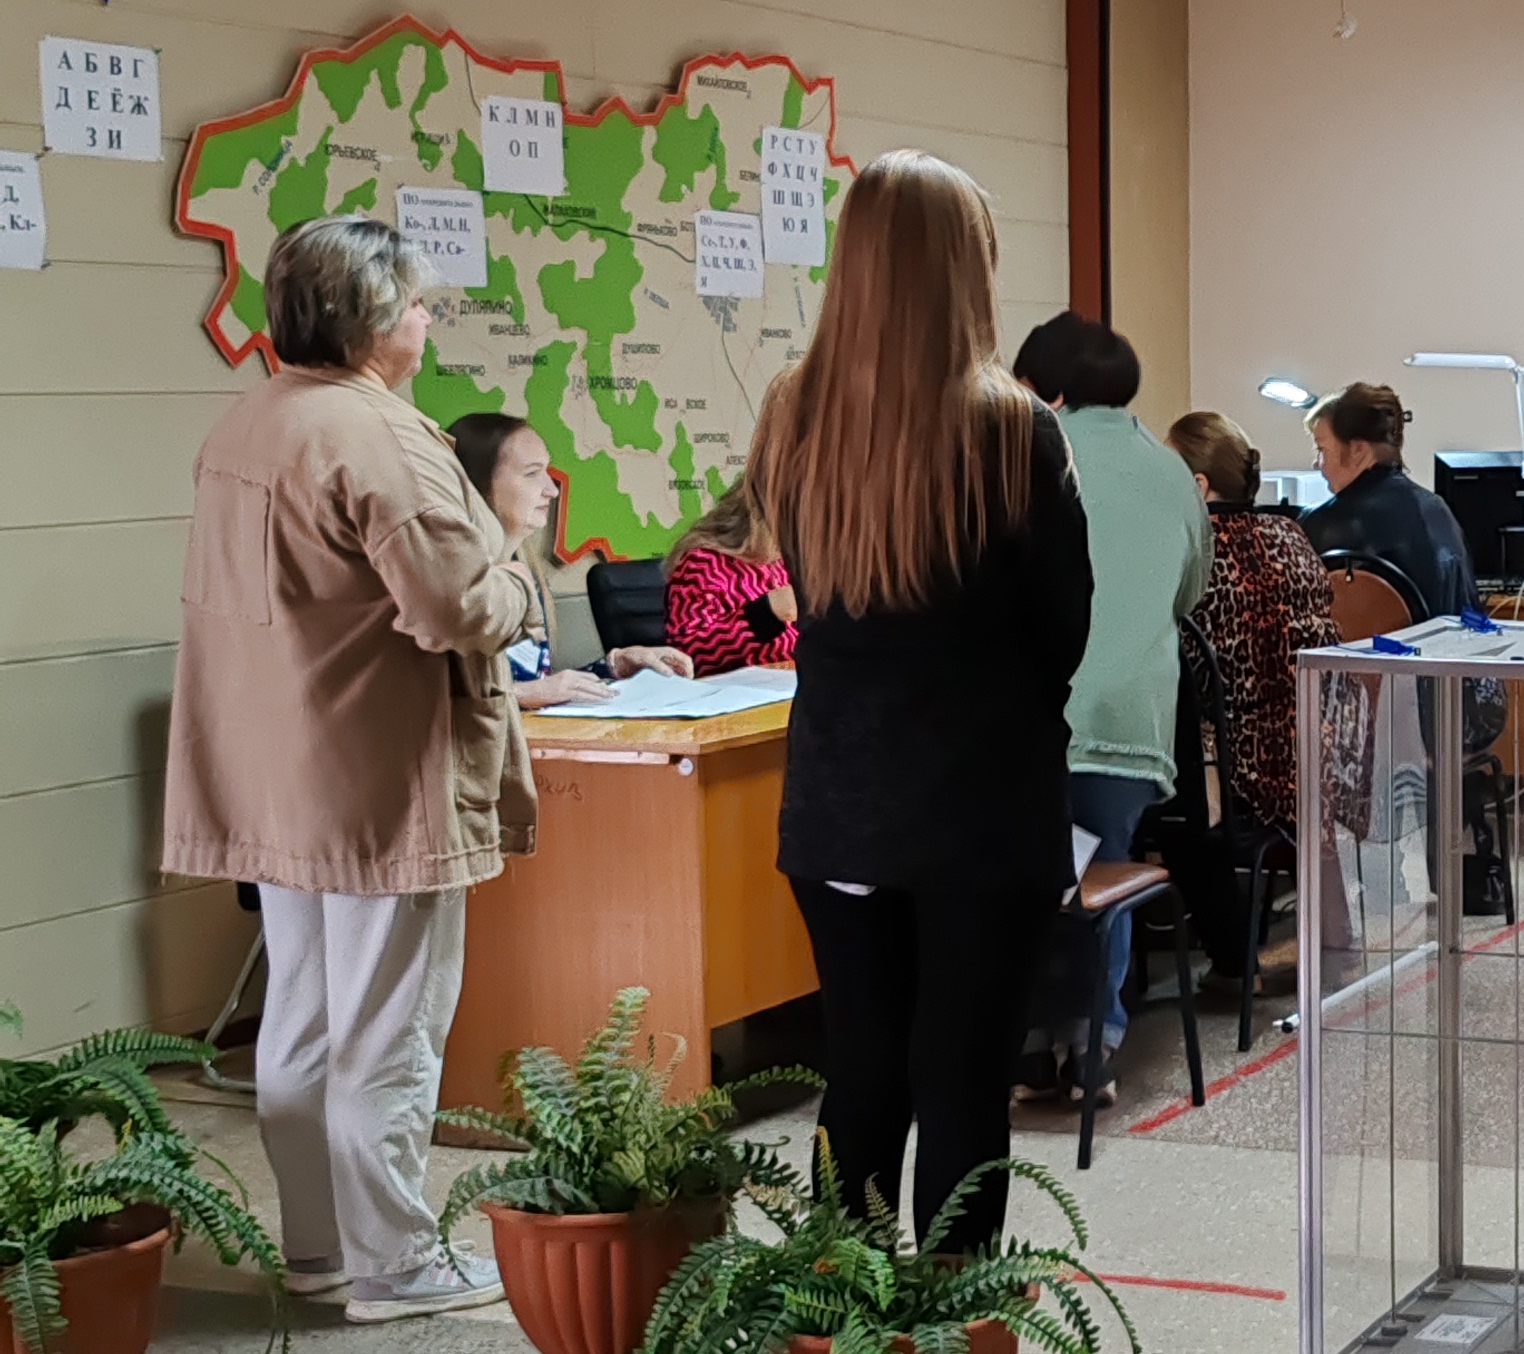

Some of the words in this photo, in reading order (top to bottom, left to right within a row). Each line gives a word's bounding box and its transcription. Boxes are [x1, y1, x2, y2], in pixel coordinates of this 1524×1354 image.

[58, 50, 73, 71] А
[85, 52, 98, 74] Б
[109, 55, 122, 76] В
[132, 58, 146, 78] Г
[55, 86, 73, 111] Д
[87, 90, 100, 111] Е
[111, 88, 124, 114] Ё
[129, 95, 149, 115] Ж
[489, 105, 500, 123] К
[506, 108, 518, 125] Л
[526, 109, 539, 127] М
[546, 111, 556, 128] Н
[86, 127, 97, 147] З
[107, 129, 122, 150] И
[770, 134, 779, 150] Р
[783, 136, 792, 152] С
[797, 138, 805, 153] Т
[809, 140, 818, 155] У
[509, 140, 521, 158] О
[528, 141, 539, 159] П
[767, 162, 778, 177] Ф
[782, 163, 793, 179] Х
[796, 165, 806, 182] Ц
[810, 166, 818, 181] Ч
[773, 189, 785, 205] Ш
[791, 190, 804, 207] Щ
[809, 192, 815, 208] Э
[782, 216, 795, 232] Ю
[800, 218, 809, 234] Я
